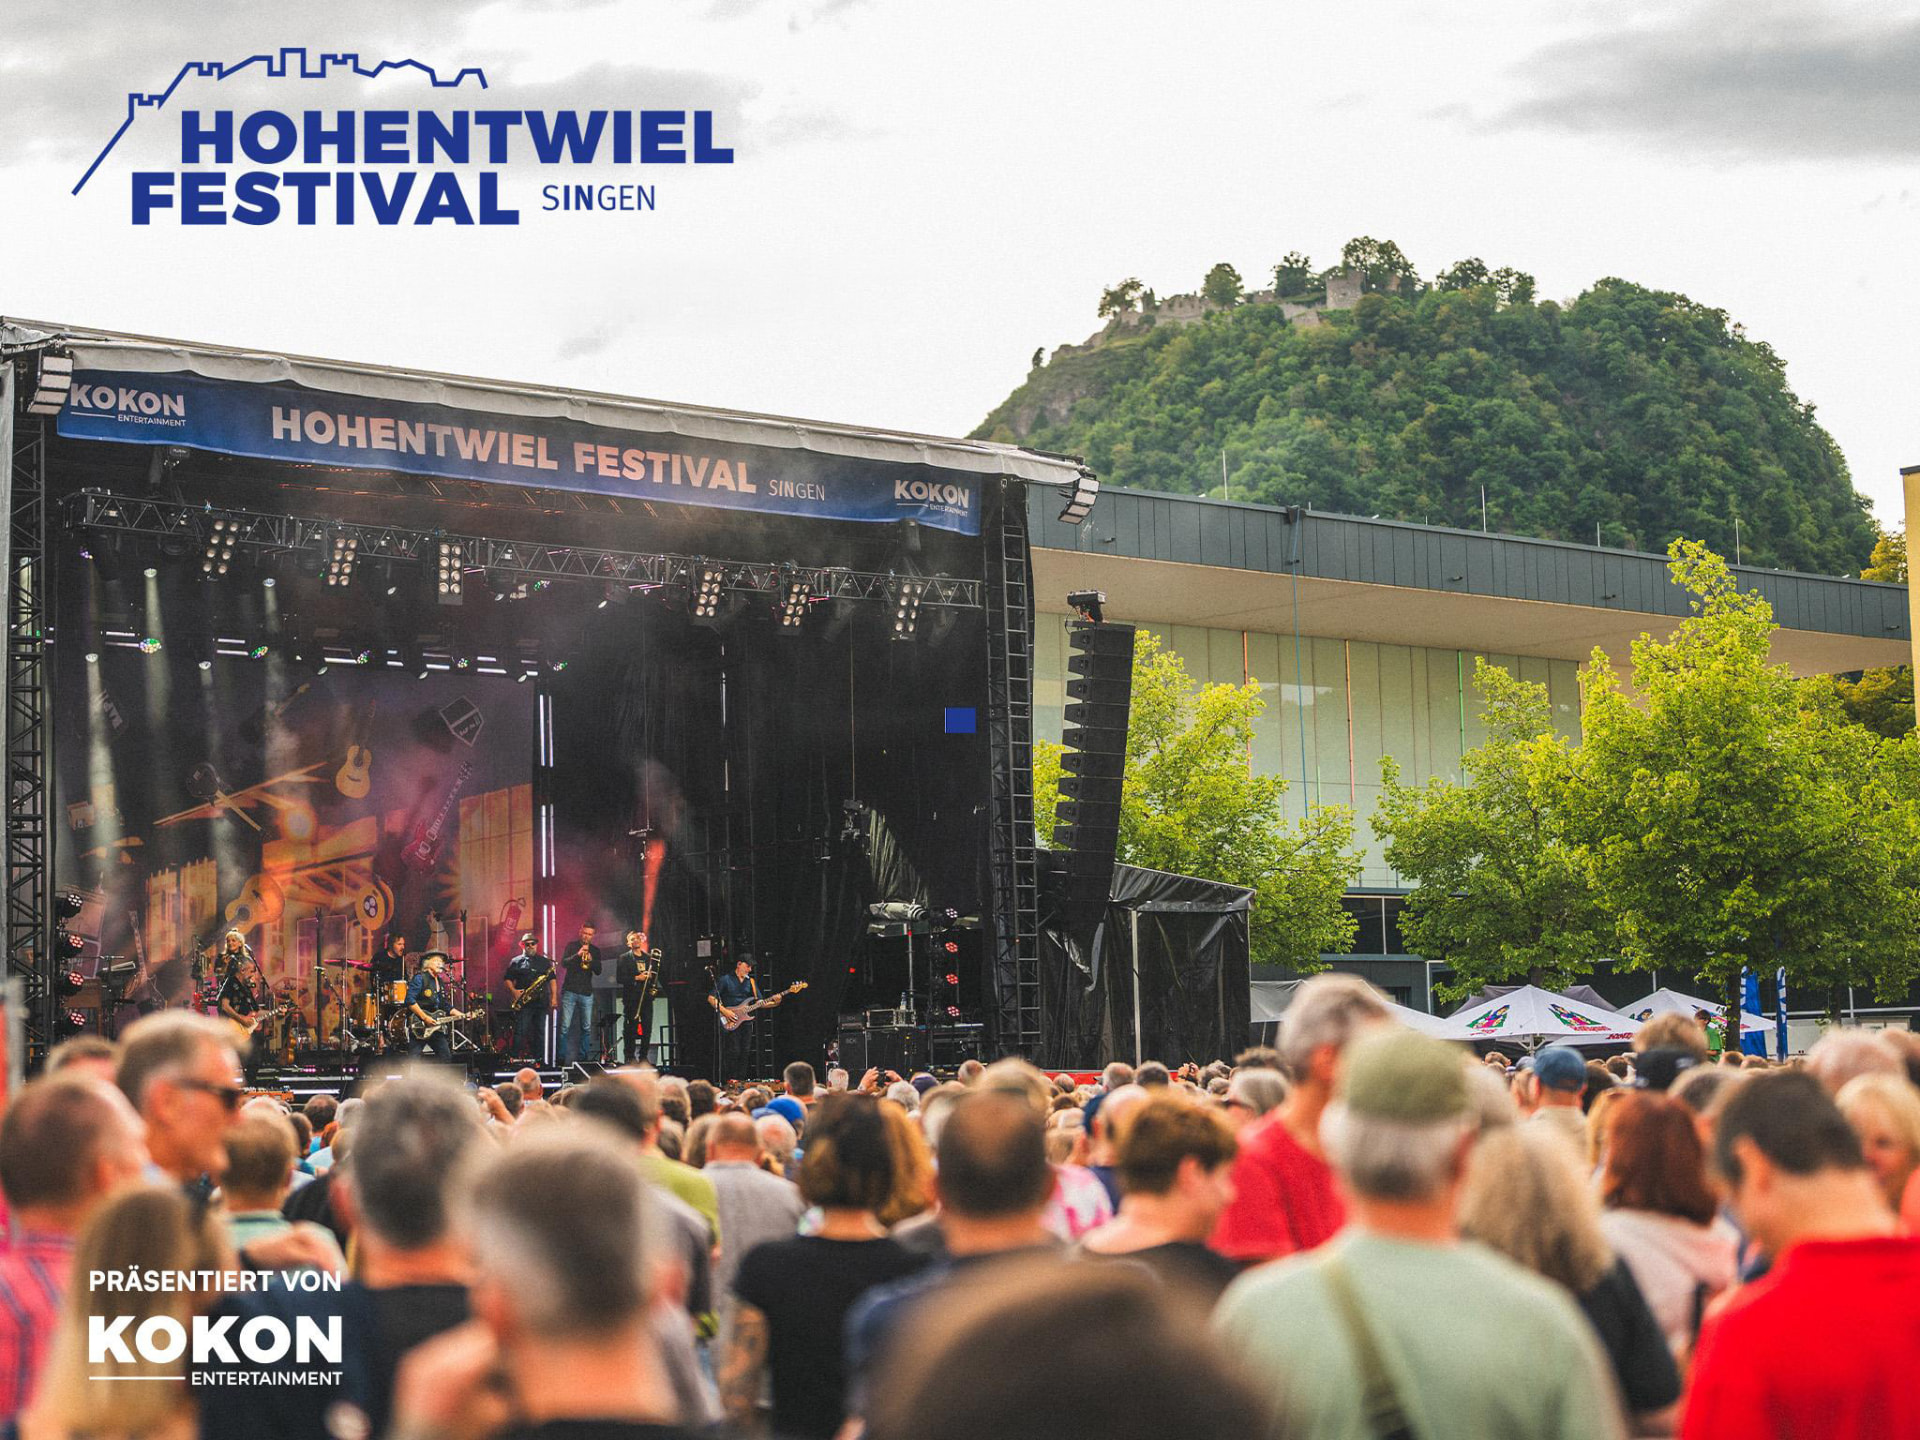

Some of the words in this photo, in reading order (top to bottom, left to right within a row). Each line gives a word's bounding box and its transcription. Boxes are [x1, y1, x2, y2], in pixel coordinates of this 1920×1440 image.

[70, 382, 185, 416] KOKON
[117, 414, 187, 427] ENTERTAINMENT
[272, 406, 558, 470] HOHENTWIEL
[573, 442, 757, 494] FESTIVAL
[768, 479, 825, 501] SINGEN
[894, 480, 970, 508] KOKON
